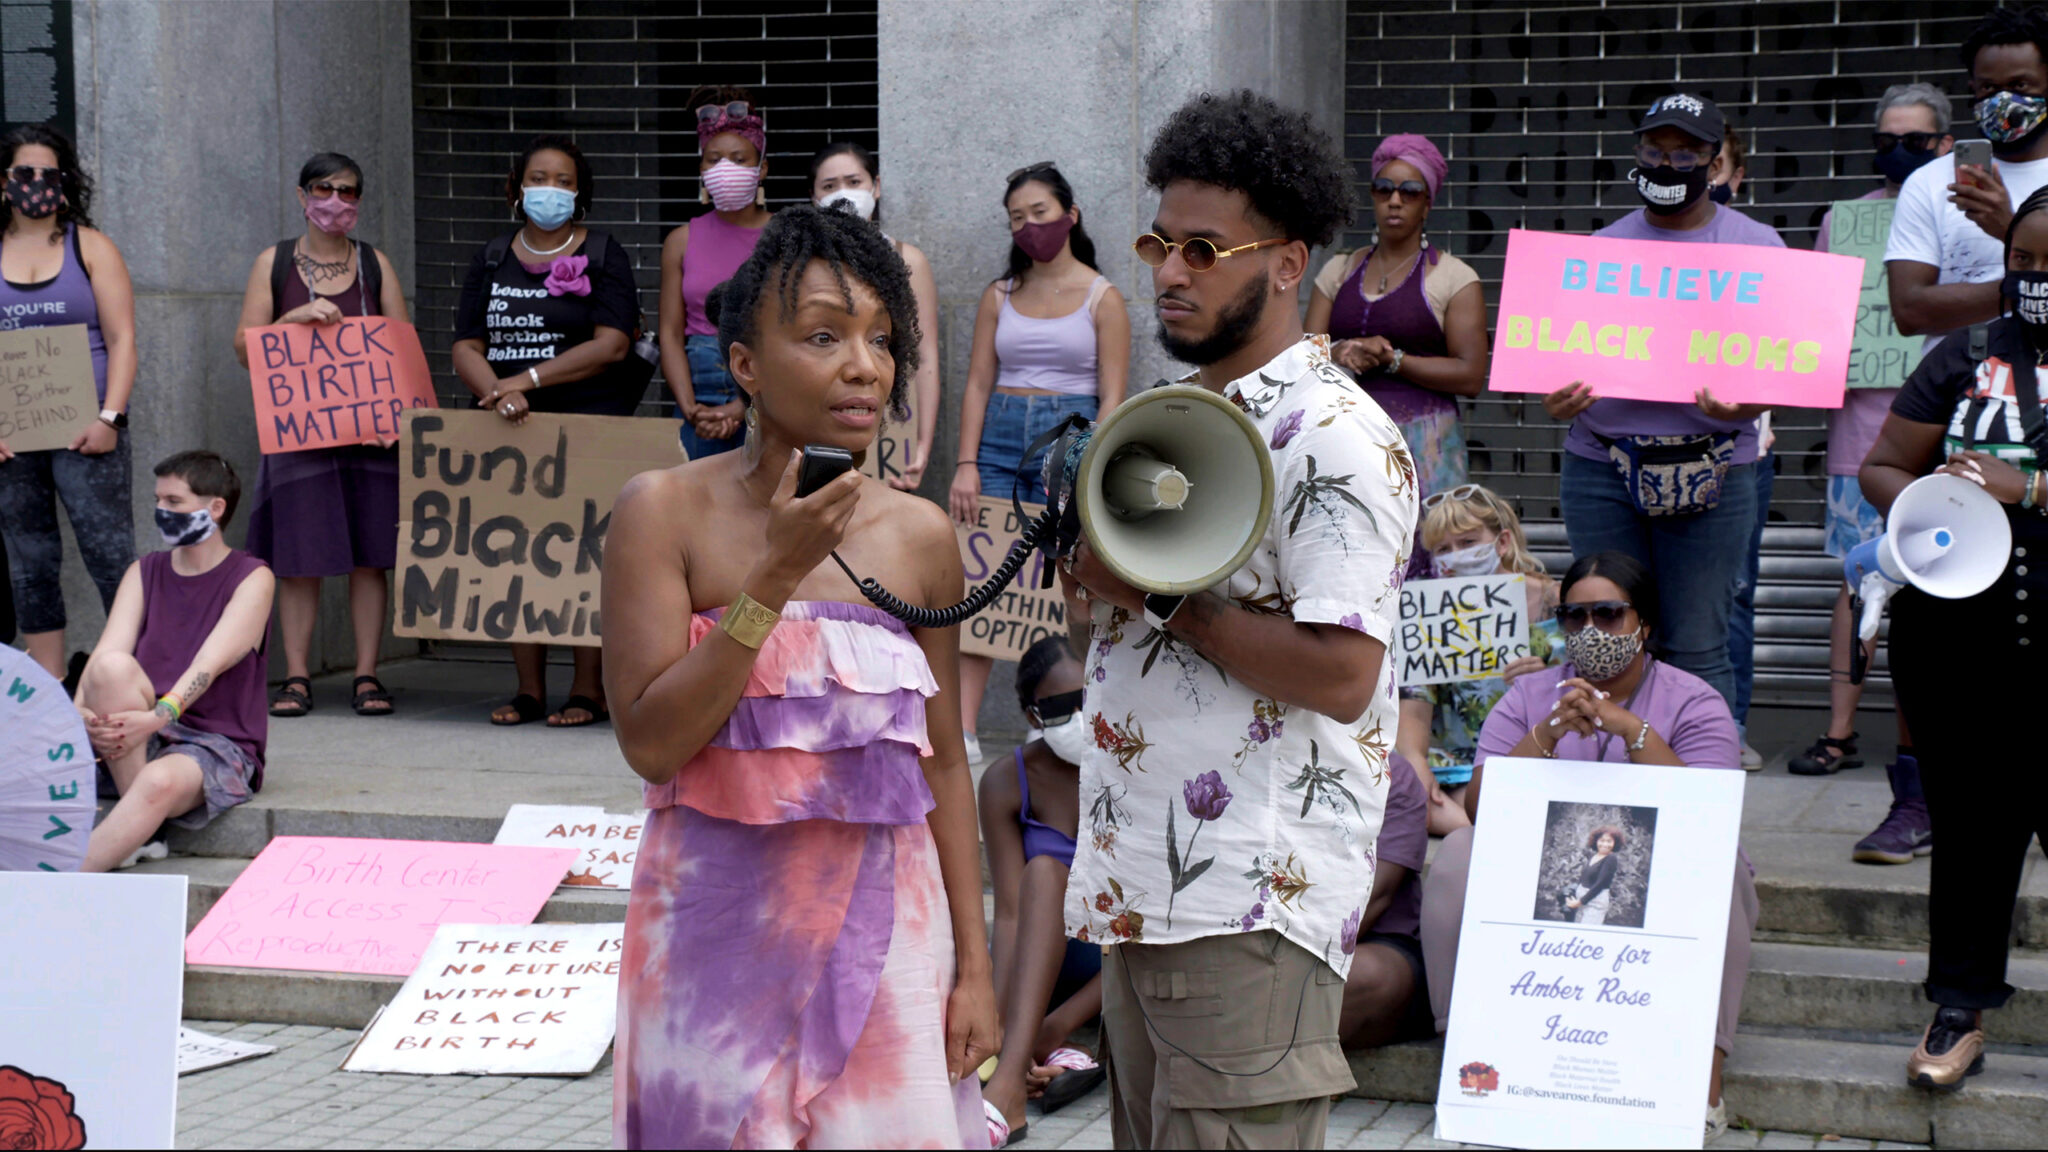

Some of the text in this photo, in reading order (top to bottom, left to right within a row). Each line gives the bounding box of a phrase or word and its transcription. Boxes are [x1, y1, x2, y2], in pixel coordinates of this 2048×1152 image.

[491, 282, 548, 298] Leave
[1560, 258, 1764, 304] BELIEVE
[3, 302, 66, 317] YOU'RE
[487, 299, 509, 312] No
[2020, 297, 2048, 313] LIVE
[0, 317, 21, 330] OT
[486, 313, 545, 328] Black
[261, 322, 394, 369] BLACK
[489, 330, 565, 344] Mother
[1505, 314, 1822, 375] BLACK MOMS
[487, 345, 555, 361] Behind
[268, 360, 395, 407] BIRTH
[411, 415, 567, 499] Fund
[410, 489, 612, 579] Black
[1399, 582, 1512, 620] BLACK
[1401, 611, 1517, 652] BIRTH
[545, 823, 642, 840] AMBE
[283, 845, 499, 889] Birth Center
[270, 892, 407, 921] Access
[200, 921, 400, 961] Reproductive
[456, 938, 624, 955] THERE IS
[1521, 930, 1652, 973] Justice for
[440, 960, 620, 978] NO FUTURE
[423, 986, 581, 1001] WITHOUT
[1510, 970, 1652, 1007] Amber Rose
[414, 1009, 567, 1026] BLACK
[1541, 1014, 1609, 1046] Isaac
[394, 1036, 539, 1051] BIRTH
[1507, 1084, 1656, 1109] IG:@savearose.foundation
